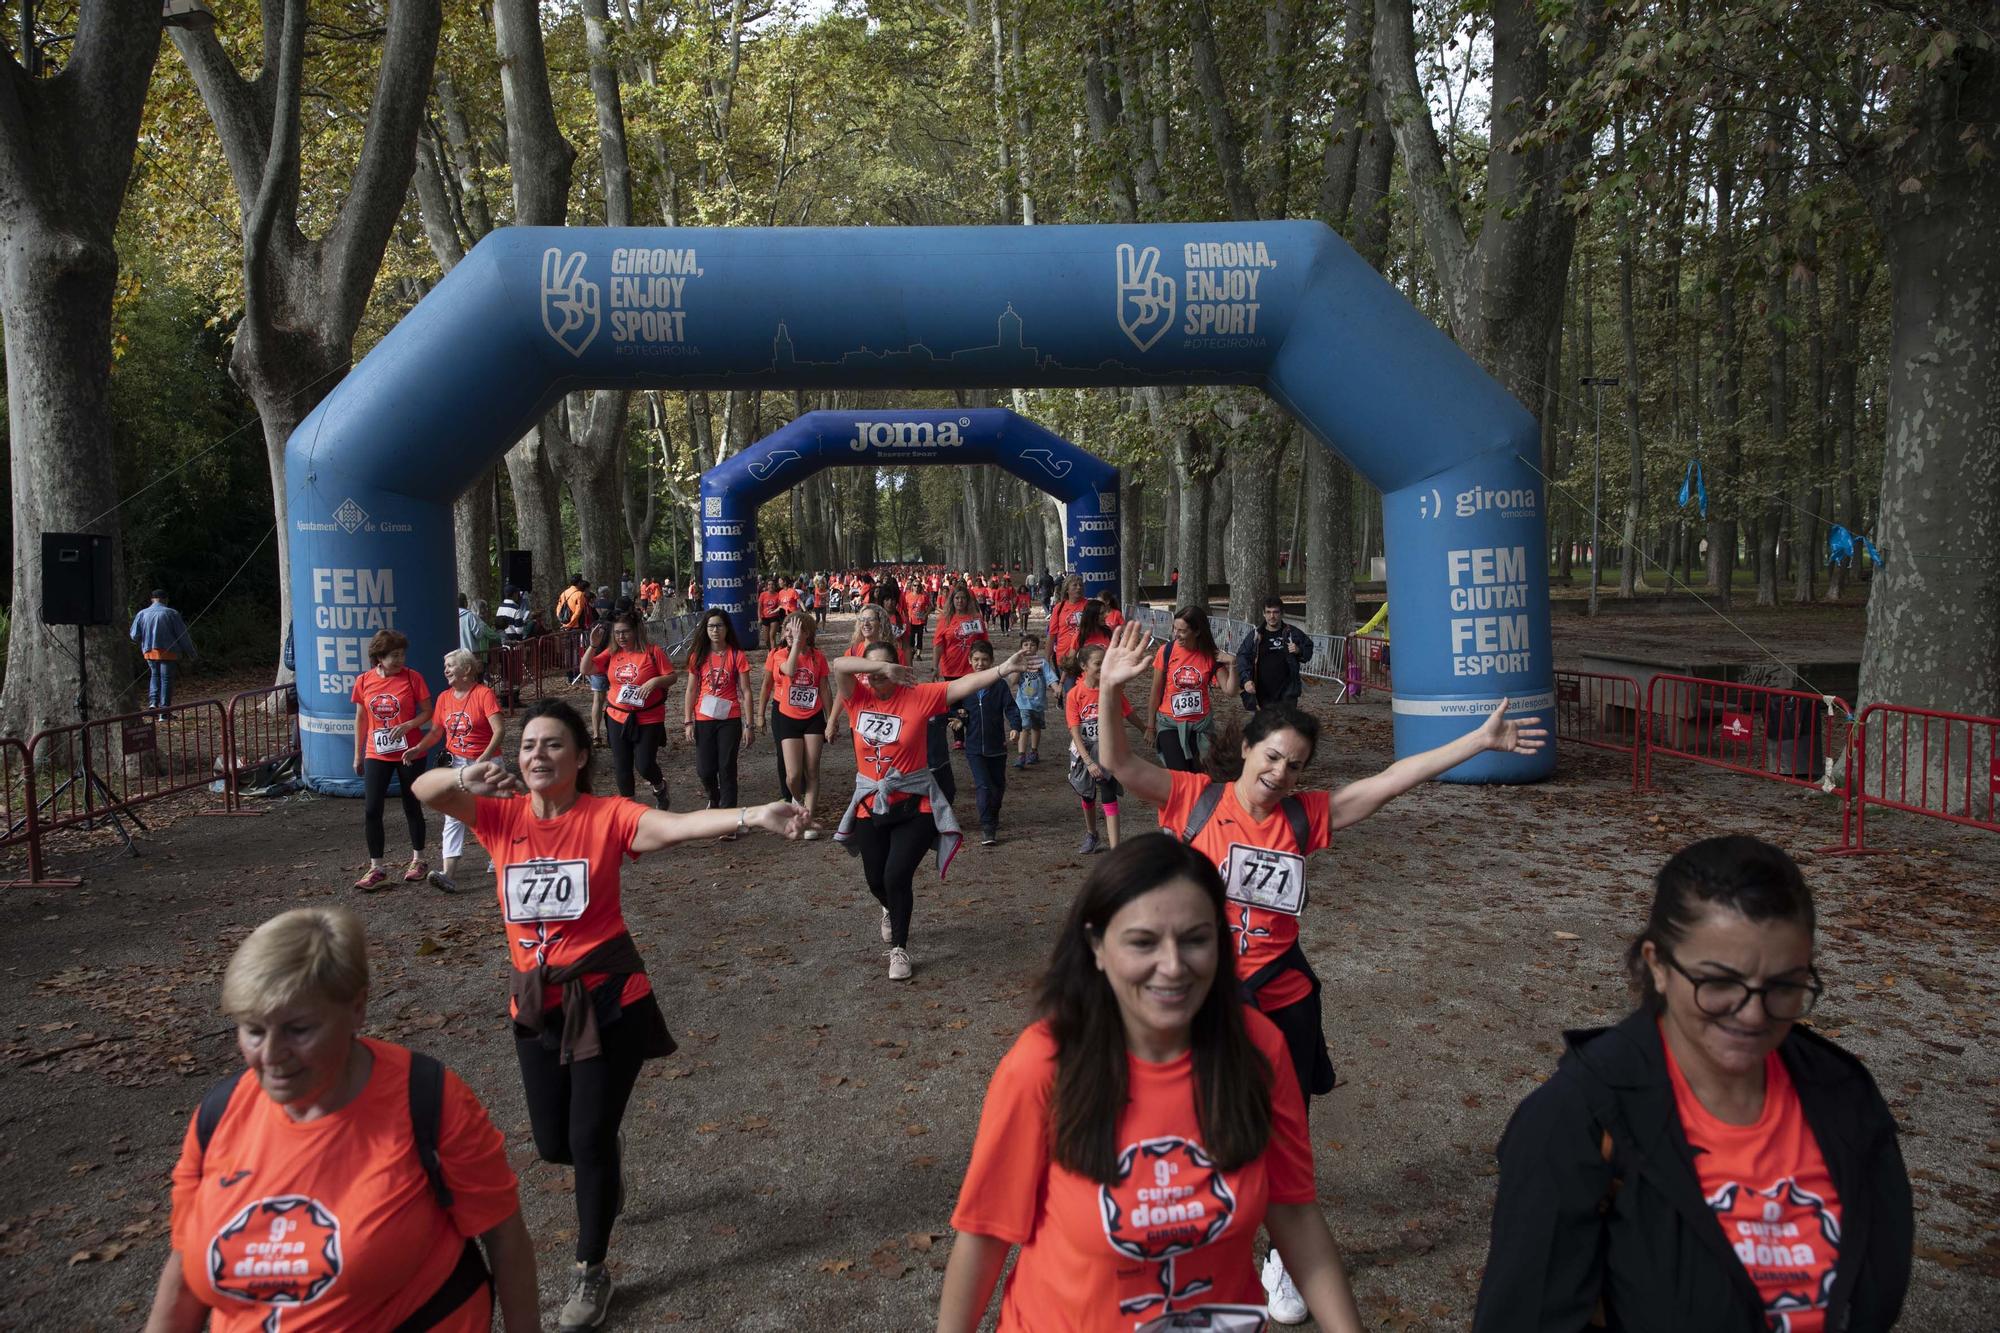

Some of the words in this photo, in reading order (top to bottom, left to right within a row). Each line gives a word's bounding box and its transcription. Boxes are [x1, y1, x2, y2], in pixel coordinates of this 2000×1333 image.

[611, 248, 704, 278] GIRONA,
[1184, 241, 1277, 270] GIRONA,
[610, 276, 686, 308] ENJOY
[1185, 269, 1261, 301] ENJOY
[610, 310, 687, 342] SPORT
[1184, 303, 1261, 336] SPORT
[1455, 485, 1536, 518] girona
[364, 521, 376, 532] de
[380, 521, 413, 533] Girona
[1447, 546, 1527, 586] FEM
[312, 567, 395, 604] FEM
[1449, 583, 1529, 612] CIUTAT
[315, 606, 398, 630] CIUTAT
[1450, 614, 1530, 654] FEM
[1453, 651, 1531, 677] ESPORT
[319, 674, 356, 695] ESP
[790, 690, 815, 703] 2558
[1173, 695, 1200, 710] 4385
[864, 718, 894, 737] 773
[521, 875, 572, 905] 770
[1240, 860, 1290, 895] 771
[1136, 1185, 1195, 1202] cursa
[1130, 1200, 1206, 1228] dona
[1146, 1225, 1199, 1242] GIRONA
[1735, 1220, 1799, 1238] cursa
[244, 1241, 306, 1256] cursa
[1733, 1238, 1816, 1268] dona
[233, 1256, 309, 1277] dona
